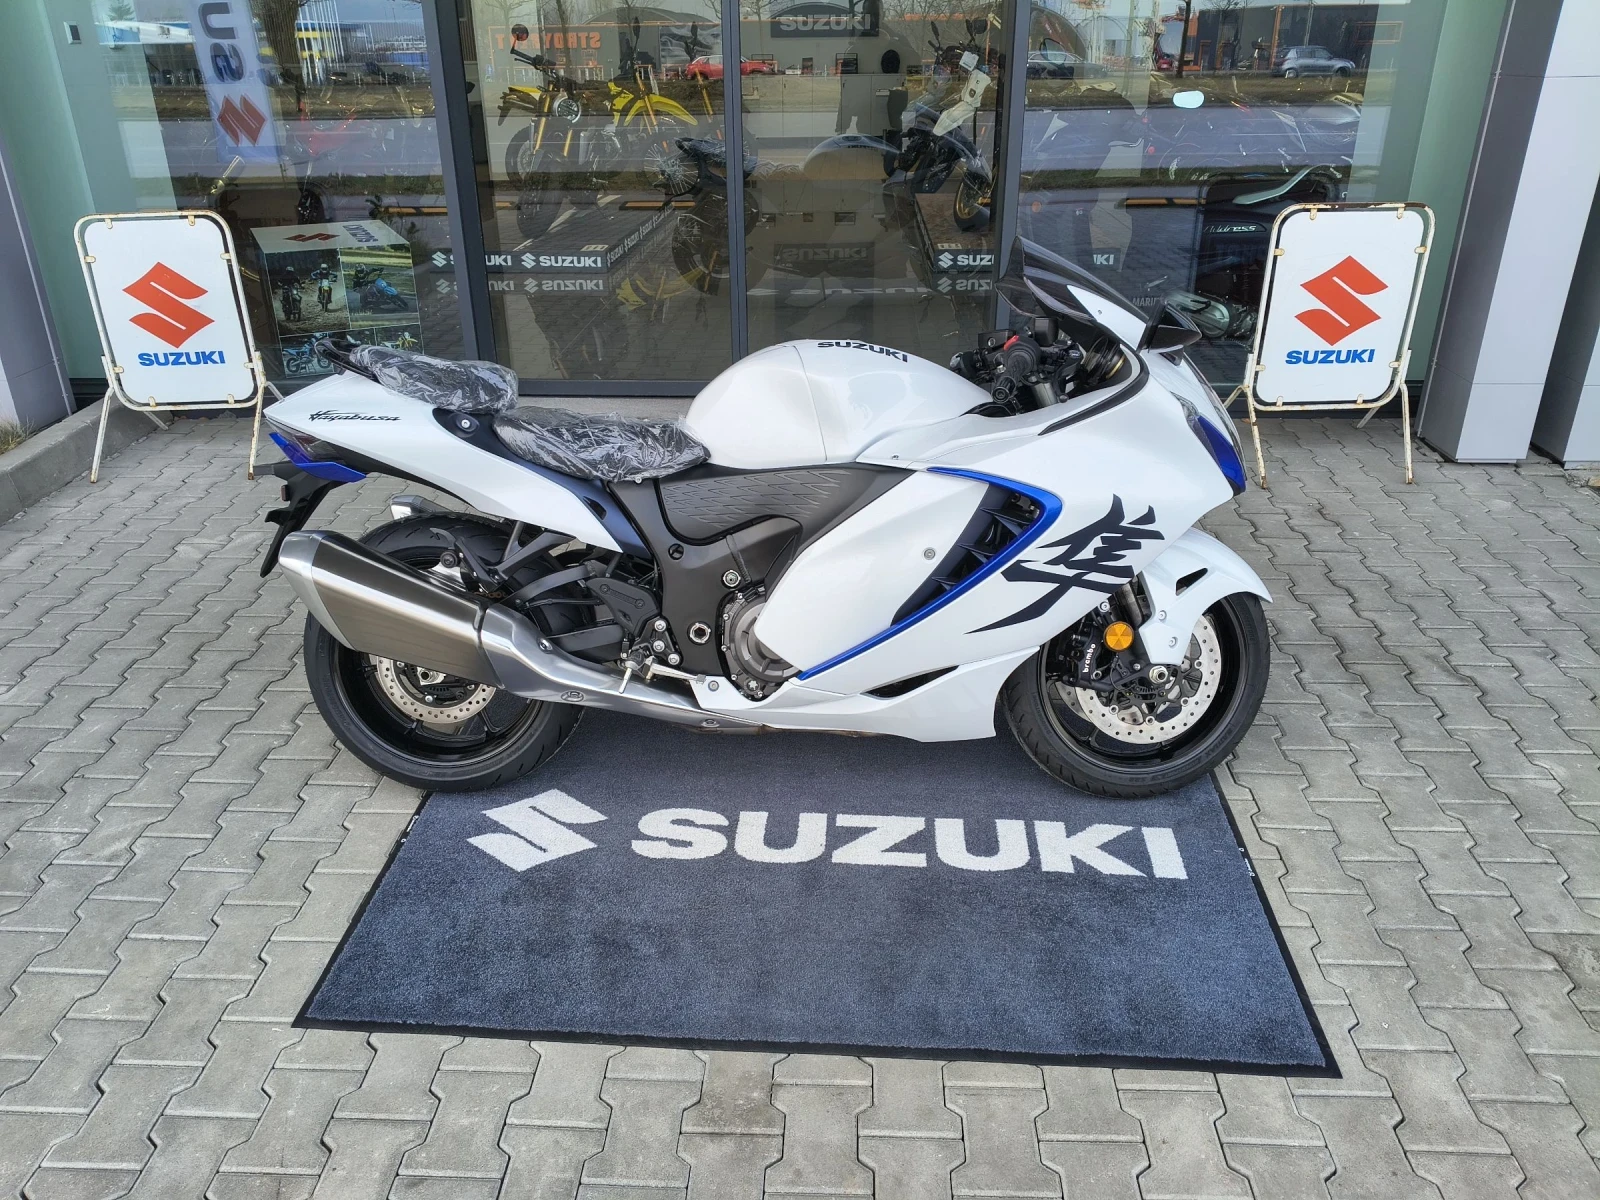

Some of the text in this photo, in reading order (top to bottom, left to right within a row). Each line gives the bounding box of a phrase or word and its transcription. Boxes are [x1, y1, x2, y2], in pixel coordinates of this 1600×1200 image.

[780, 14, 871, 30] SUZUKI
[539, 256, 602, 268] SUZUKI
[957, 254, 994, 265] SUZ
[137, 350, 226, 366] SUZUKI
[817, 341, 908, 363] SUZUKI
[1285, 348, 1376, 365] SUZUKI
[308, 409, 402, 422] Hayabusa
[963, 493, 1166, 635] 隼
[1082, 643, 1096, 673] brembo
[630, 806, 1189, 880] SUZUKI
